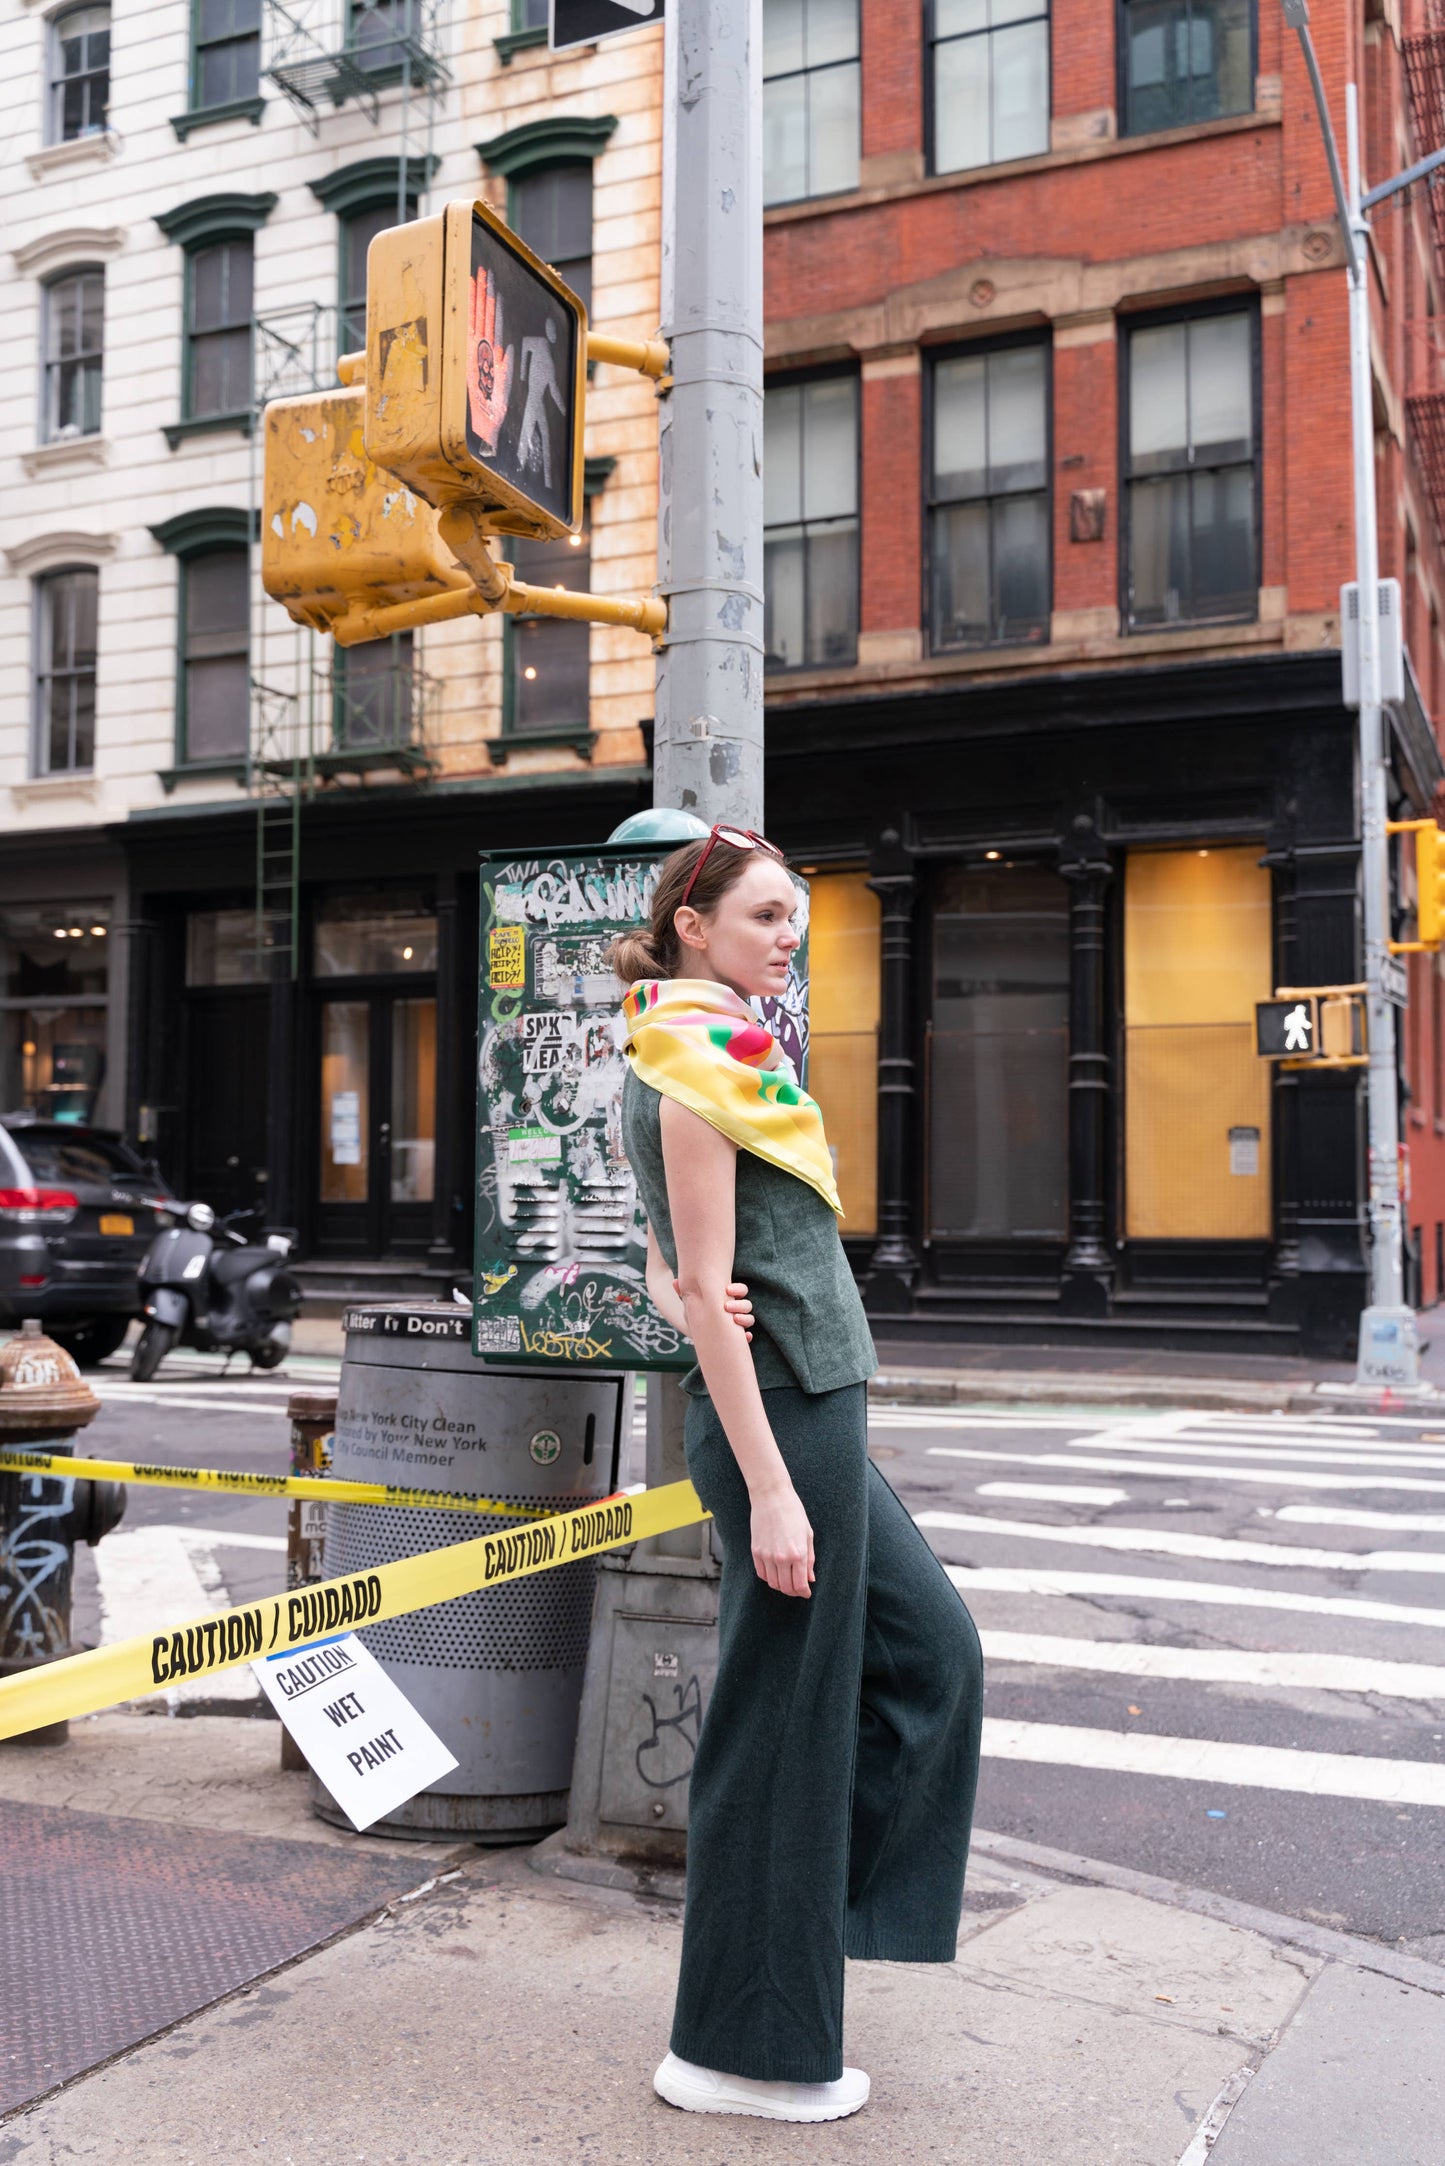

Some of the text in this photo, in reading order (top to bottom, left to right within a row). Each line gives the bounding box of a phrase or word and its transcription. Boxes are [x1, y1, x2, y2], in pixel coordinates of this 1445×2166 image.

[526, 1016, 572, 1036] SNK
[407, 1317, 463, 1335] Don't
[371, 1411, 397, 1426] York
[401, 1415, 428, 1432] City
[432, 1417, 476, 1434] Clean
[351, 1443, 389, 1460] Council
[392, 1449, 455, 1467] Member
[365, 1427, 377, 1444] by
[414, 1434, 447, 1449] New
[453, 1436, 488, 1452] York
[485, 1525, 556, 1580] CAUTION
[571, 1502, 633, 1554] CUIDADO
[151, 1609, 263, 1684] CAUTION
[288, 1575, 382, 1642] CUIDADO
[276, 1645, 354, 1696] CAUTION
[323, 1691, 366, 1728] WET
[346, 1728, 404, 1776] PAINT
